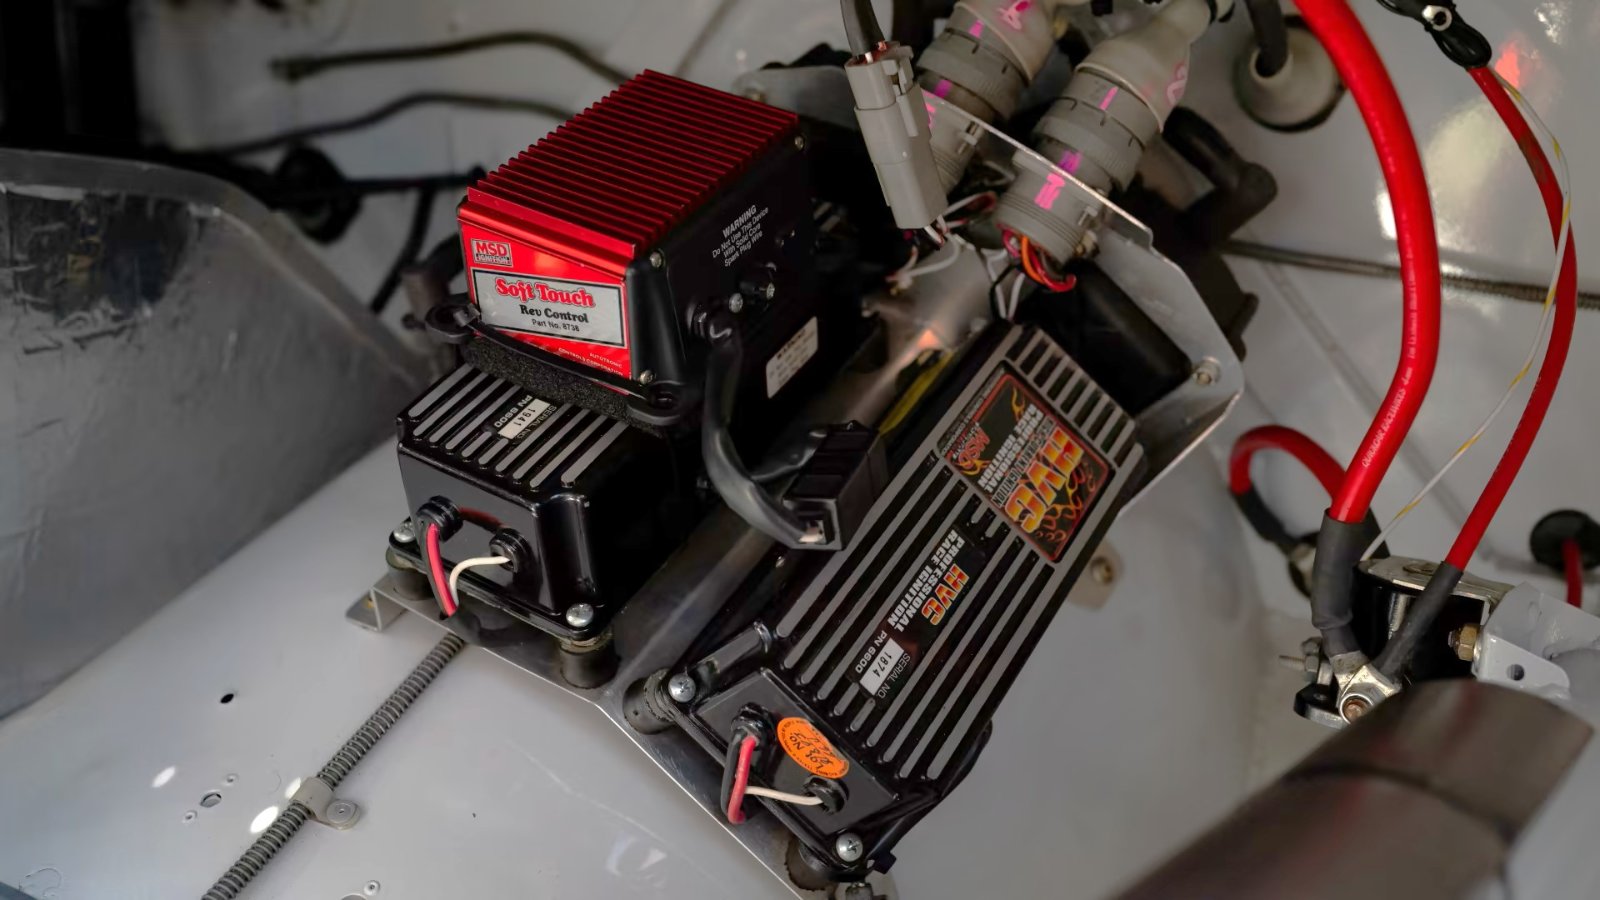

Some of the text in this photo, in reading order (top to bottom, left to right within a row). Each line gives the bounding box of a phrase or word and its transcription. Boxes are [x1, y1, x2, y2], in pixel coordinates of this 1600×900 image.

[712, 207, 768, 258] Do Not Use This Device
[722, 204, 756, 238] WARNING
[476, 242, 507, 256] MSD
[723, 245, 735, 257] With
[736, 233, 748, 248] Solid
[724, 230, 762, 267] Spark Plug Wire
[495, 278, 596, 308] Soft Touch
[520, 304, 589, 323] Rev Control
[532, 319, 547, 328] Part
[562, 323, 580, 332] 8738
[513, 408, 536, 426] 1941
[517, 395, 533, 407] PN
[529, 405, 557, 427] SERIAL
[977, 402, 1037, 487] RACE IGNITION
[984, 408, 1044, 494] PROFESSIONAL
[992, 467, 1021, 509] IGNITION
[1004, 426, 1084, 533] HVC
[887, 529, 958, 626] RACE IGNITION
[894, 536, 965, 633] PROFESSIONAL
[921, 563, 970, 626] HVC
[855, 630, 888, 674] PN 6600
[873, 652, 892, 677] 1874
[887, 653, 911, 681] SERIAL
